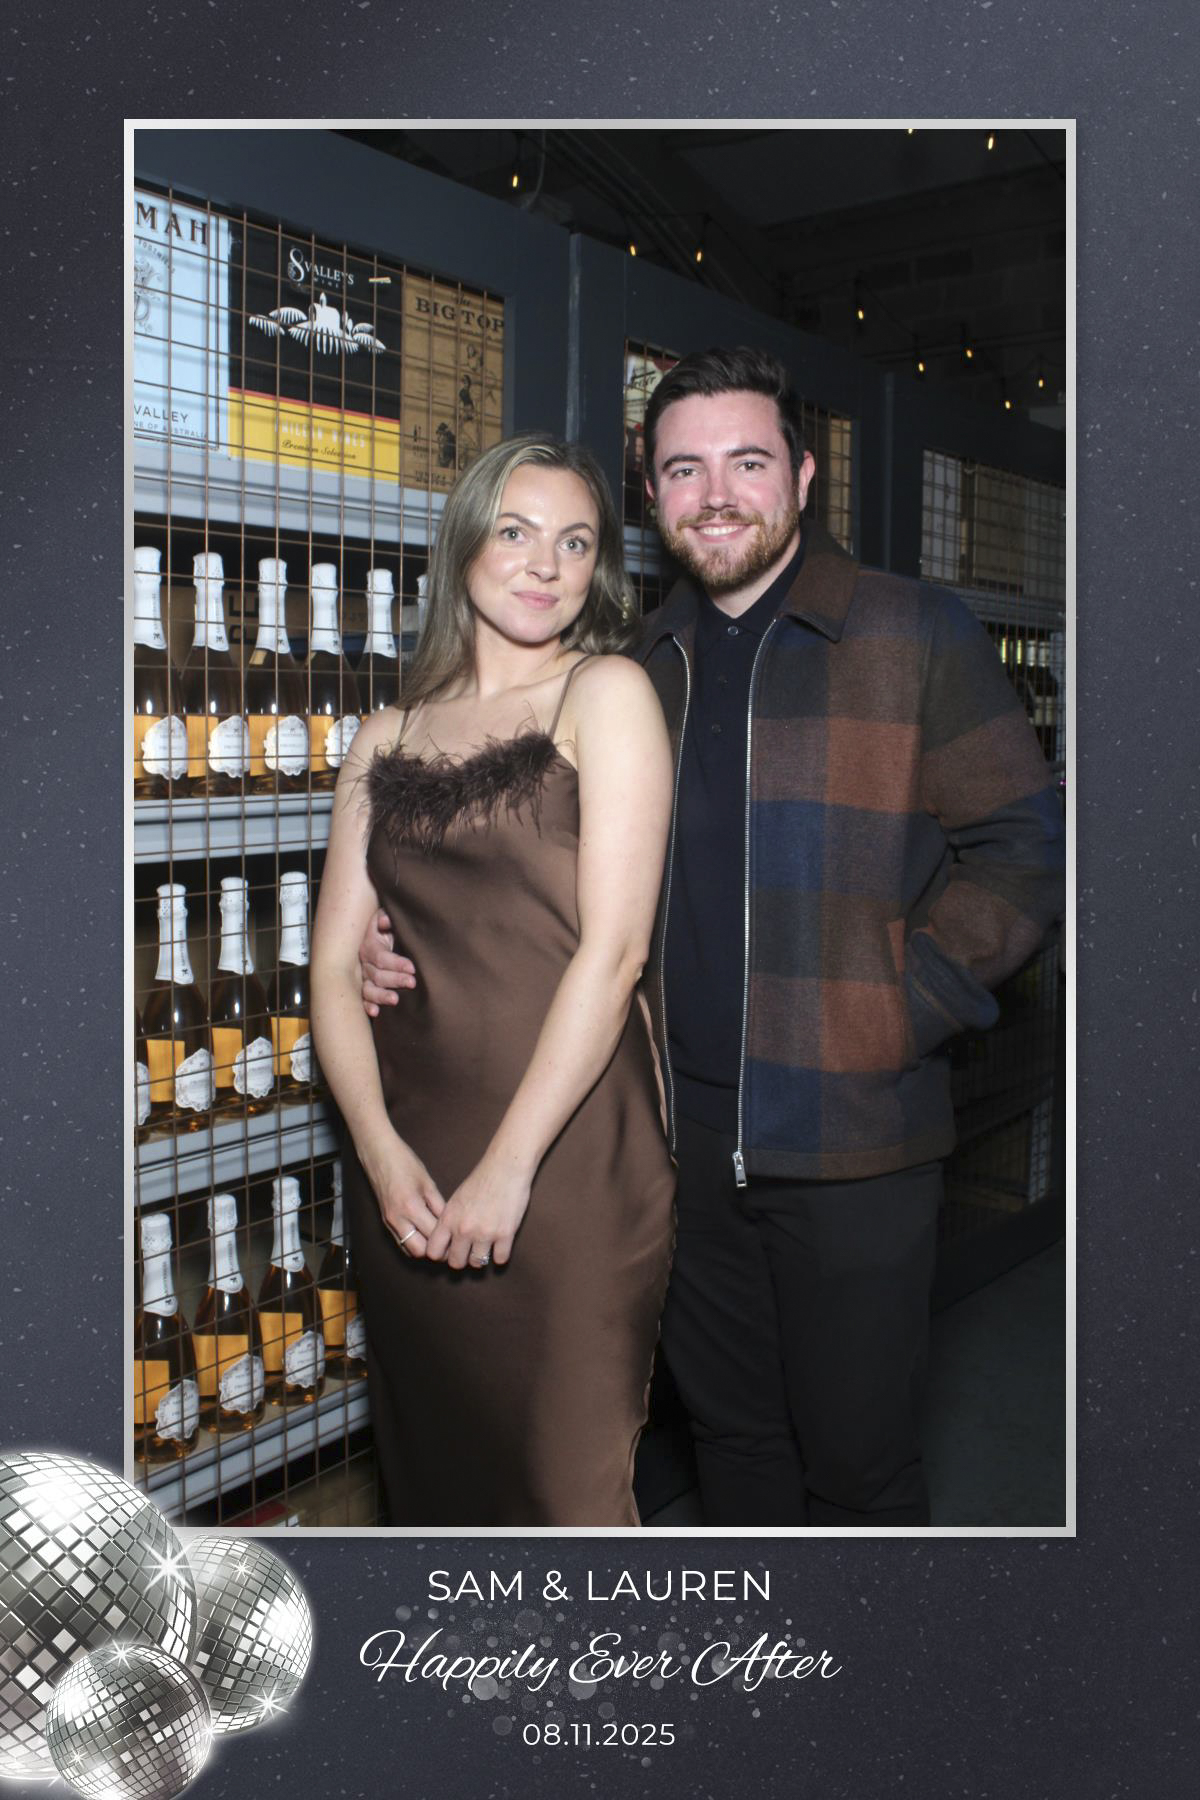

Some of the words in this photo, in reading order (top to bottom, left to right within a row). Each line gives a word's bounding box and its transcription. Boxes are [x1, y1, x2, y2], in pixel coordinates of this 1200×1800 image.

[135, 201, 208, 246] MAH
[415, 297, 456, 320] BIG
[461, 309, 504, 332] TOP
[134, 404, 188, 424] VALLEY
[162, 425, 208, 439] ASTRALIA
